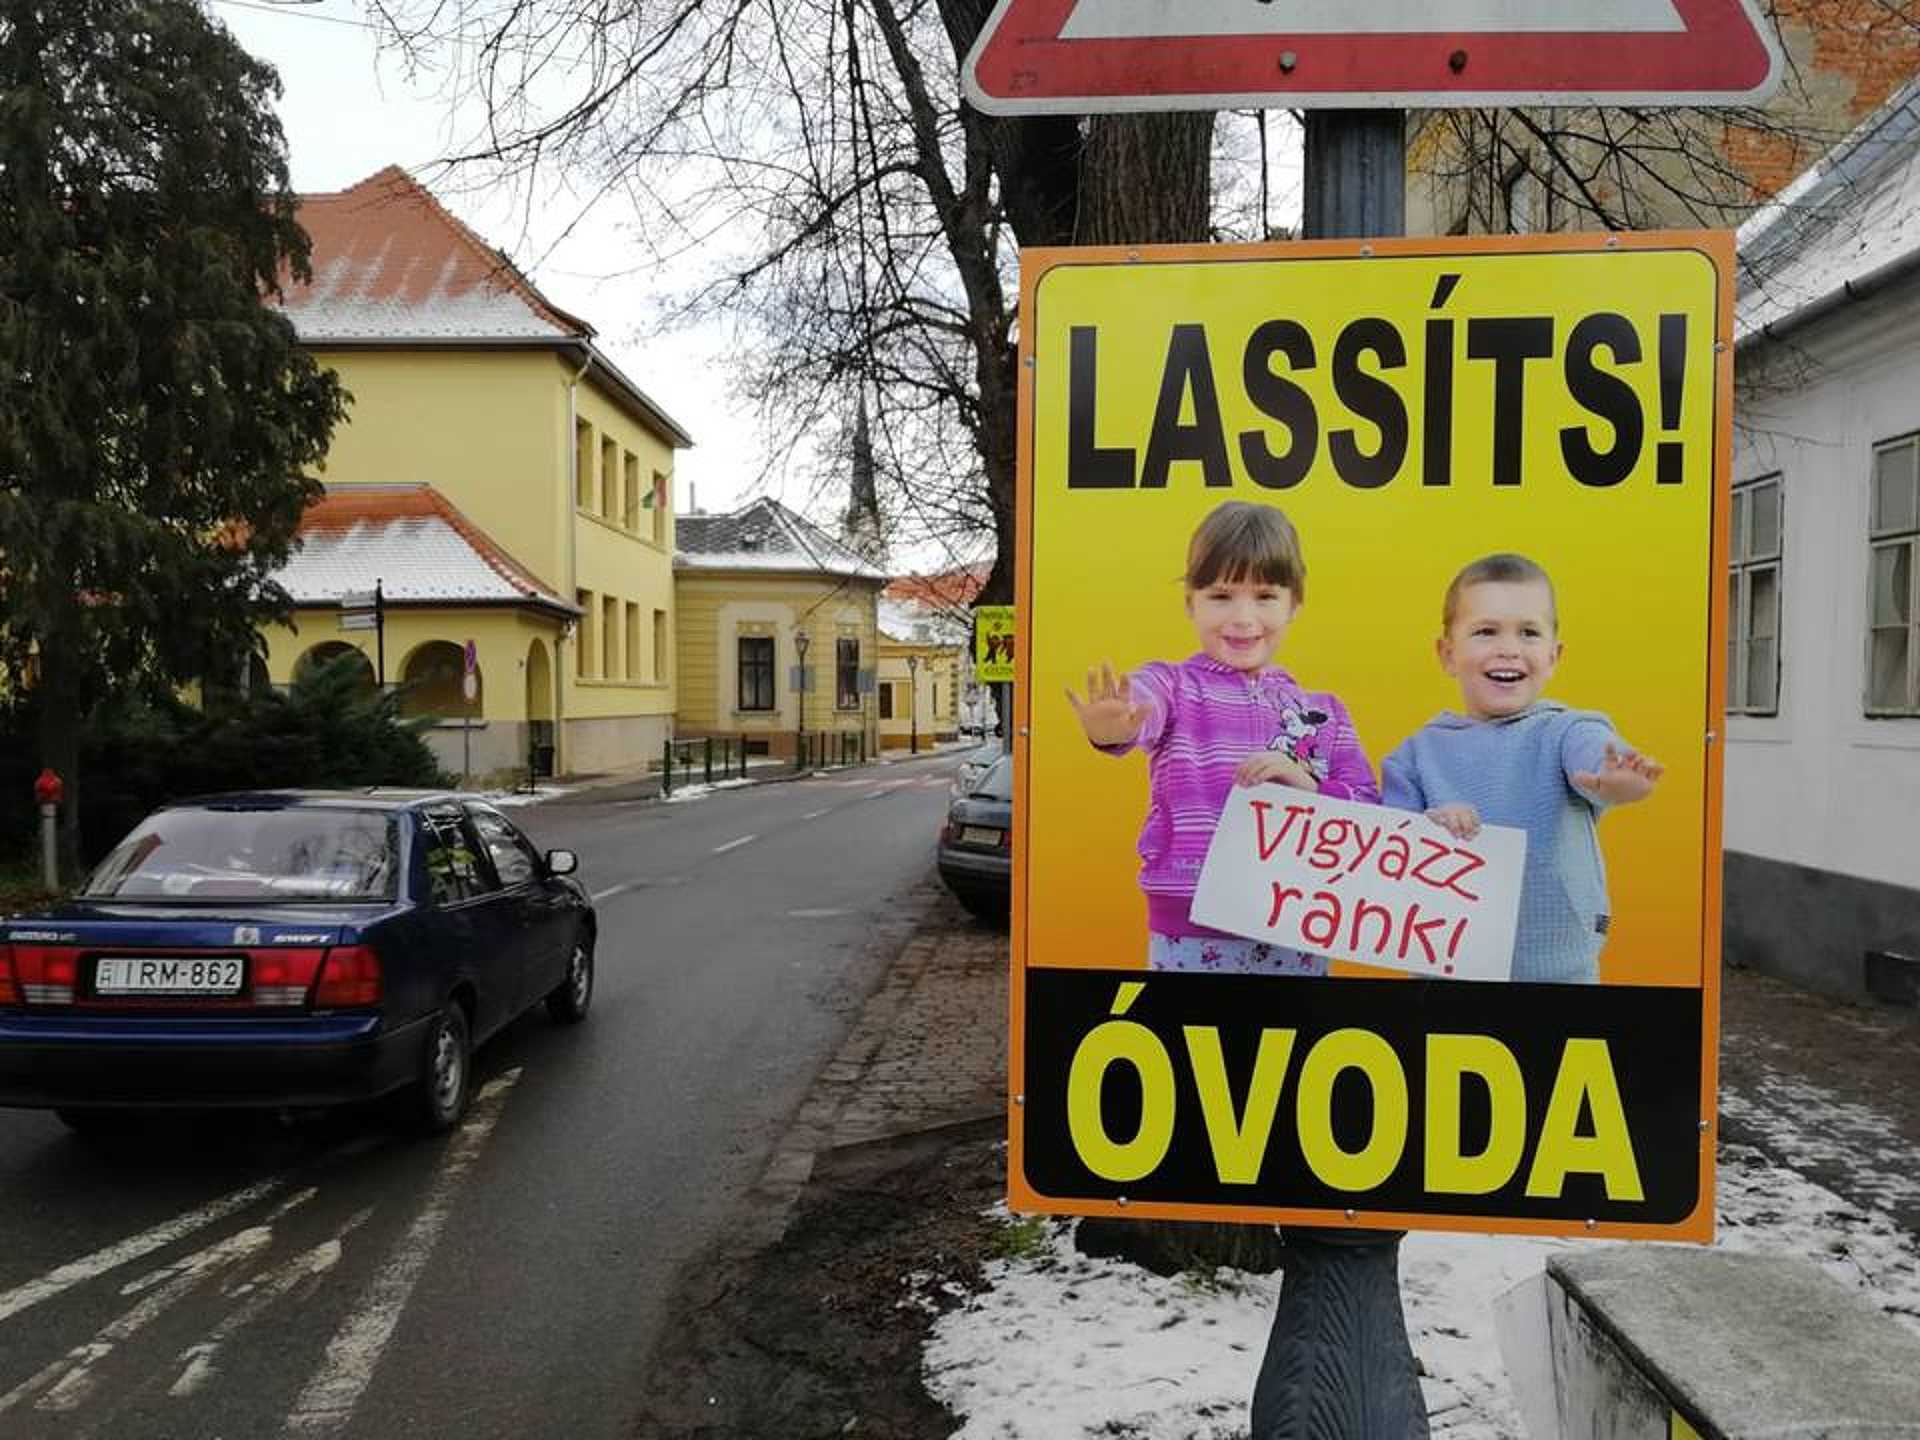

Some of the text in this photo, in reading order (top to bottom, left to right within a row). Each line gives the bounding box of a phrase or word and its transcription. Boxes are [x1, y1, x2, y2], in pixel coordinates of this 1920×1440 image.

[1068, 274, 1689, 490] LASSÍTS!
[1249, 800, 1486, 901] Vigyázz
[126, 961, 239, 986] IRM-862
[1266, 872, 1469, 975] ránk!
[1067, 981, 1646, 1202] ÓVODA
